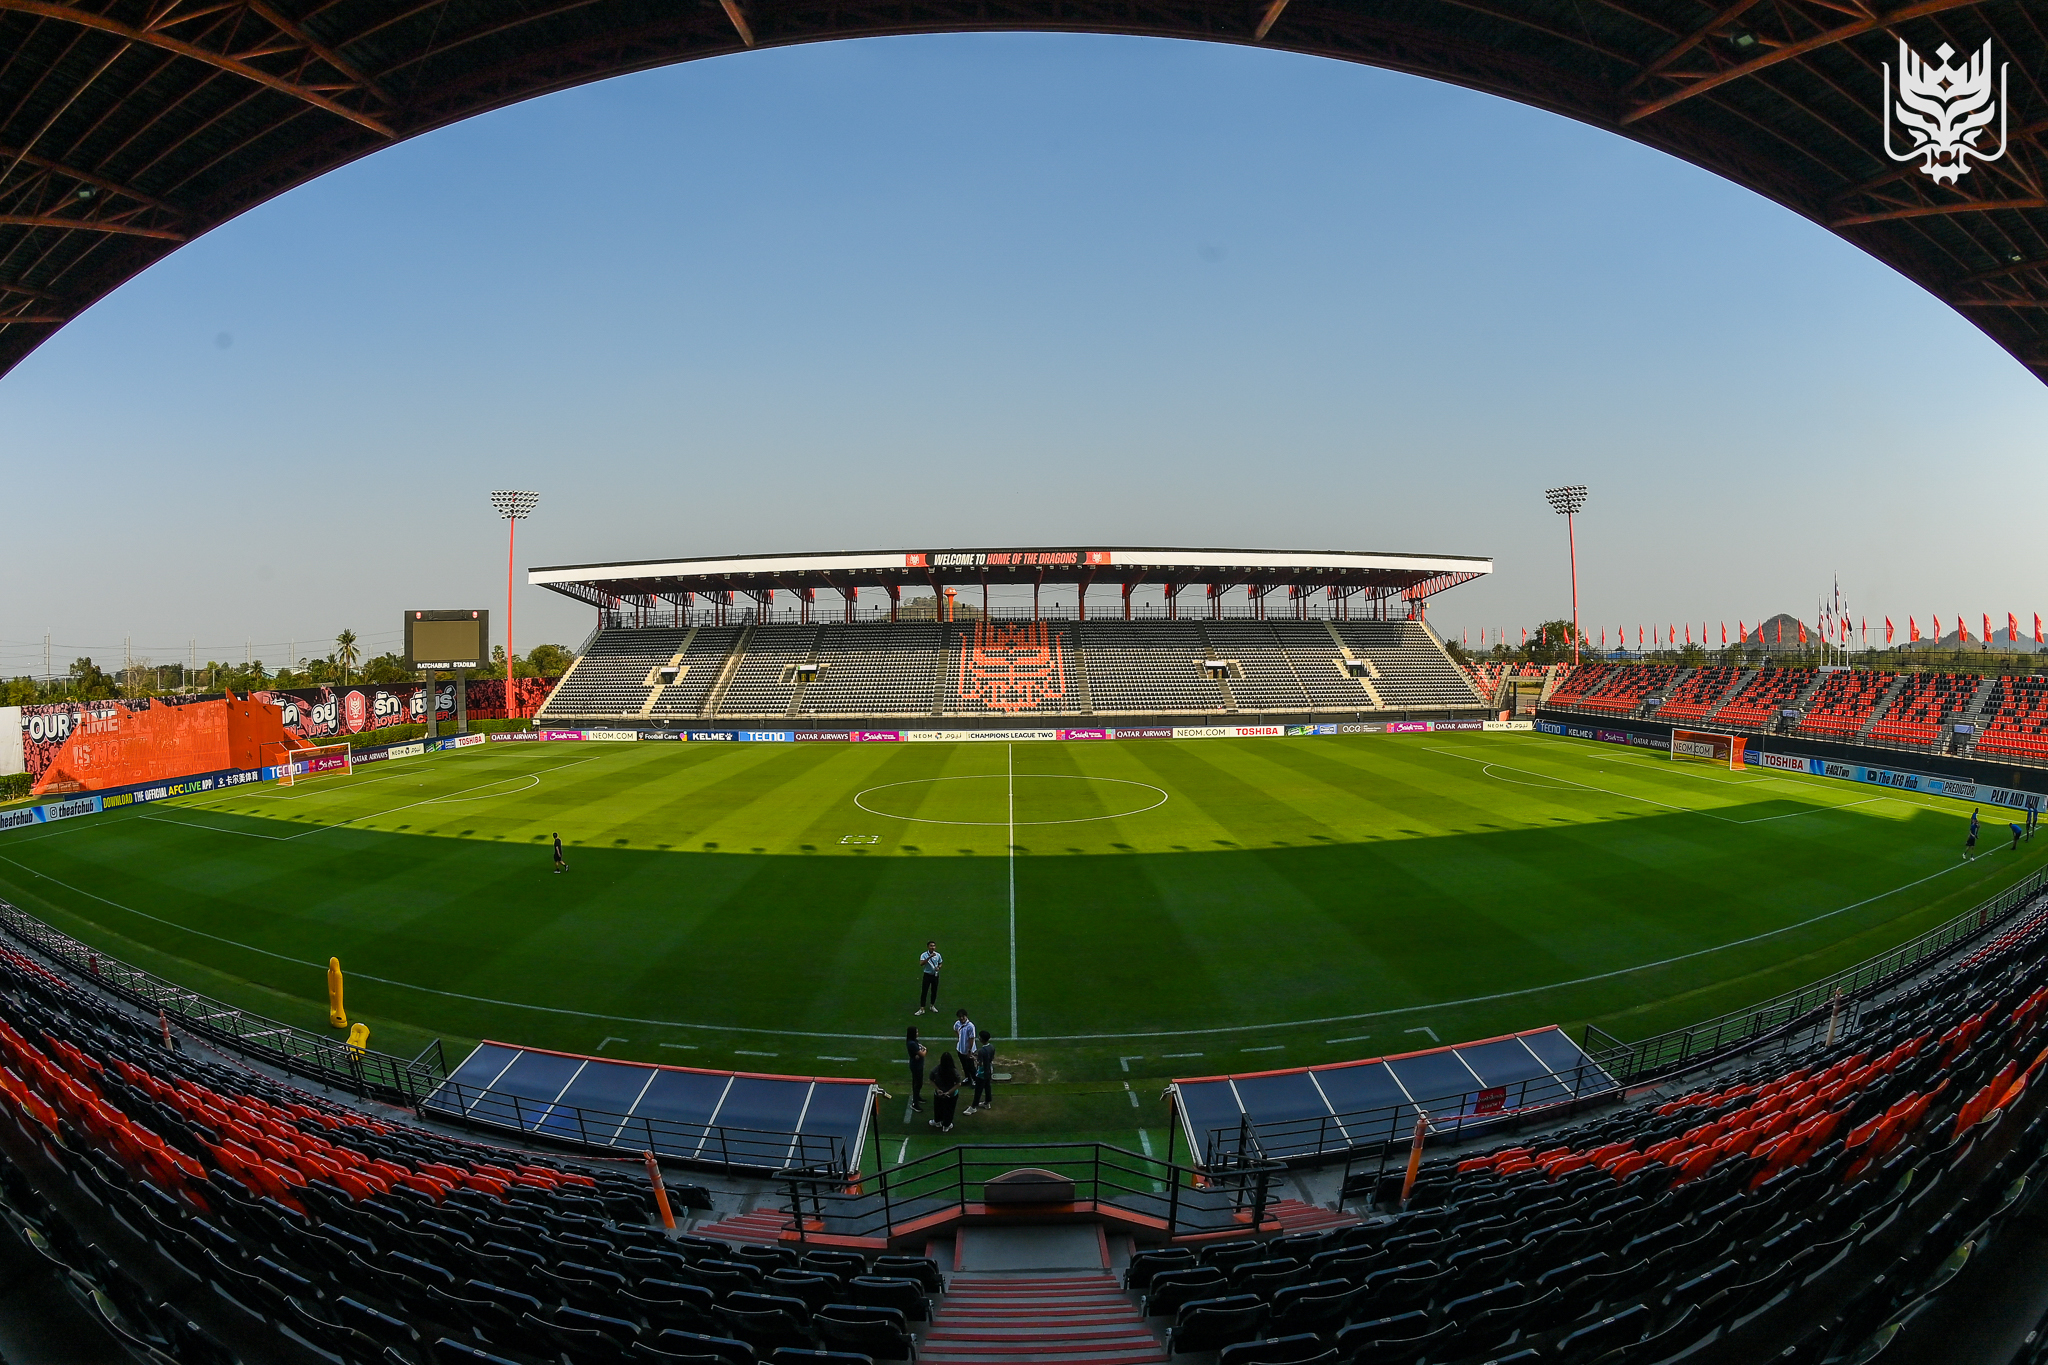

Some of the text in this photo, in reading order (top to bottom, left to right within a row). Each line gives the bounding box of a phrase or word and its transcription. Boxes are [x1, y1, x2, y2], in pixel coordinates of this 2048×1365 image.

[934, 552, 1078, 565] WELCOME TO HOME OF THE DRAGONS
[313, 696, 336, 728] อยู่
[375, 715, 400, 727] LOVE
[310, 724, 328, 736] LIVE
[1541, 723, 1560, 734] TECNO
[1568, 728, 1588, 738] KELME
[458, 736, 482, 746] TOSHIBA
[748, 732, 785, 741] TECNO
[1633, 737, 1648, 746] QATAR
[1650, 738, 1670, 748] AIRWAYS
[1674, 742, 1710, 755] NEOM.COM
[352, 751, 388, 763] QATAR AIRWAYS
[1765, 755, 1803, 770] TOSHIBA
[1825, 764, 1849, 778] #ACLTwo
[1879, 772, 1890, 784] The
[1891, 774, 1904, 787] AFC
[1904, 776, 1918, 789] Hub
[103, 779, 212, 808] DOWNLOAD THE OFFICIAL AFC LIVE APP
[1945, 782, 1975, 796] PREDICTOR
[1991, 790, 2009, 804] PLAY
[2009, 793, 2023, 806] AND
[58, 800, 93, 817] theafchub
